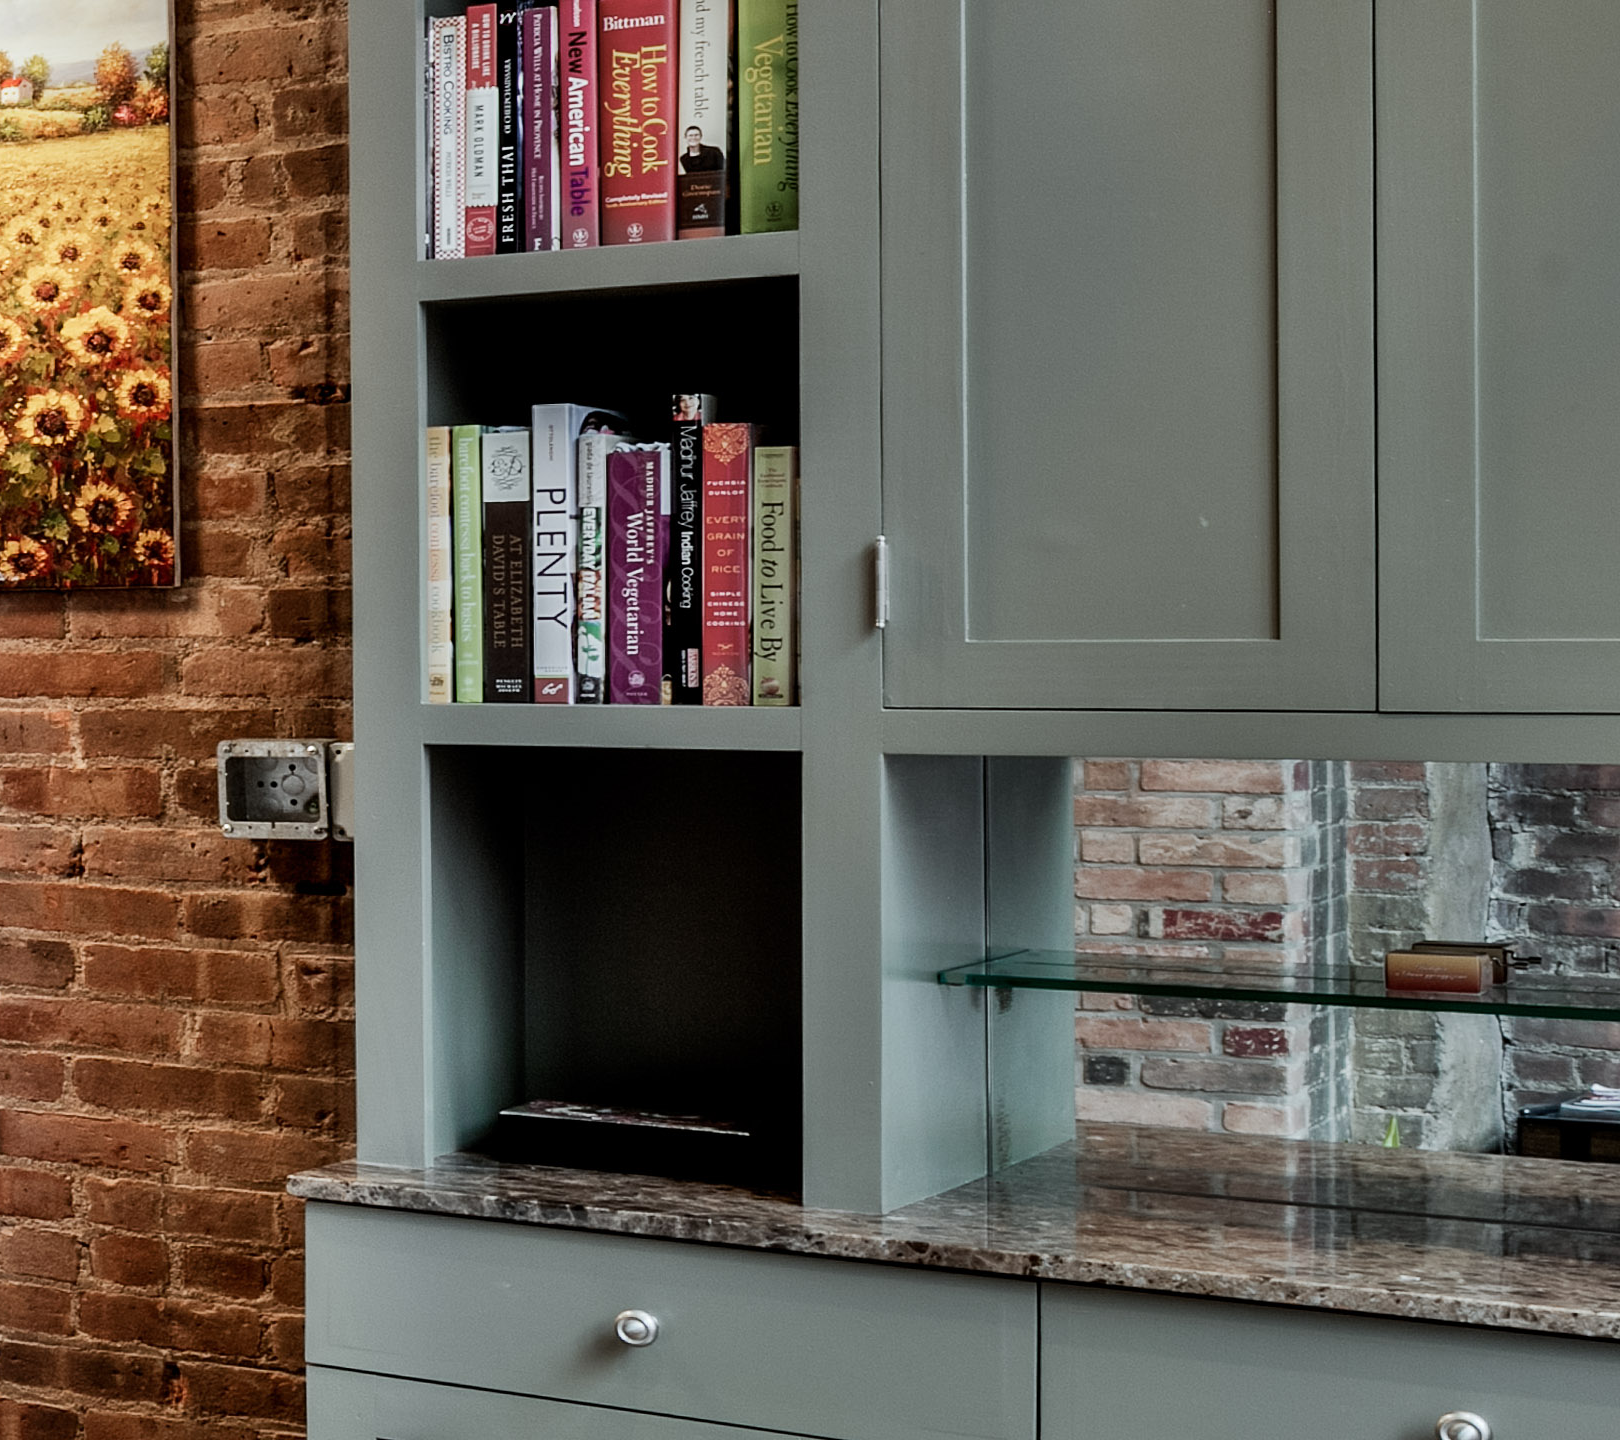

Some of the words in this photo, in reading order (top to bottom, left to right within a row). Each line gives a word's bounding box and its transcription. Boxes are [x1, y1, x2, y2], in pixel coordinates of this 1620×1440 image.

[482, 13, 491, 28] HOW
[482, 29, 491, 38] TO
[533, 13, 544, 46] PATRICIA
[603, 14, 666, 32] Bittman
[690, 16, 705, 36] my
[443, 34, 455, 78] BISTRO
[471, 29, 480, 70] BILLIONAIRE
[482, 39, 491, 63] DRINK
[482, 63, 491, 77] LIKE
[533, 46, 544, 72] WELLS
[568, 31, 588, 73] New
[640, 43, 668, 92] How
[694, 40, 711, 83] french
[533, 73, 543, 83] AT
[533, 83, 544, 109] HOME
[443, 80, 455, 136] COOKING
[473, 105, 484, 133] MARK
[533, 109, 543, 119] IN
[603, 48, 642, 177] Everything
[641, 97, 666, 116] to
[693, 86, 710, 118] table
[743, 33, 784, 166] Vegetarian
[533, 120, 544, 160] PROVENCE
[567, 76, 591, 166] American
[473, 136, 484, 178] OLDMAN
[501, 145, 515, 187] THAI
[641, 117, 669, 174] Cook
[569, 166, 593, 217] Table
[501, 192, 515, 243] FRESH
[429, 436, 442, 458] the
[457, 436, 475, 491] barefoot
[679, 425, 696, 480] Madhur
[429, 462, 442, 518] barefoot
[644, 461, 655, 506] MADHUR
[458, 493, 473, 551] contessa
[678, 483, 696, 528] Jaffrey
[706, 515, 747, 525] EVERY
[761, 501, 784, 552] Food
[429, 522, 441, 583] contessa
[509, 534, 523, 557] AT
[582, 507, 597, 569] EVERYDAY
[626, 512, 645, 569] World
[643, 508, 655, 565] JAFFREY'S
[679, 530, 695, 565] Indian
[706, 532, 746, 542] GRAIN
[716, 548, 735, 558] OF
[459, 553, 476, 584] back
[492, 534, 505, 596] DAVID'S
[536, 488, 568, 629] PLENTY
[711, 565, 741, 574] RICE
[761, 558, 778, 578] to
[460, 585, 475, 600] to
[509, 561, 524, 648] ELIZABETH
[581, 570, 597, 620] ITALIAN
[678, 567, 695, 609] Cooking
[760, 582, 784, 630] Live
[430, 586, 444, 655] cookbook
[460, 601, 477, 642] basics
[492, 599, 506, 648] TABLE
[621, 567, 645, 656] Vegetarian
[754, 637, 783, 662] By
